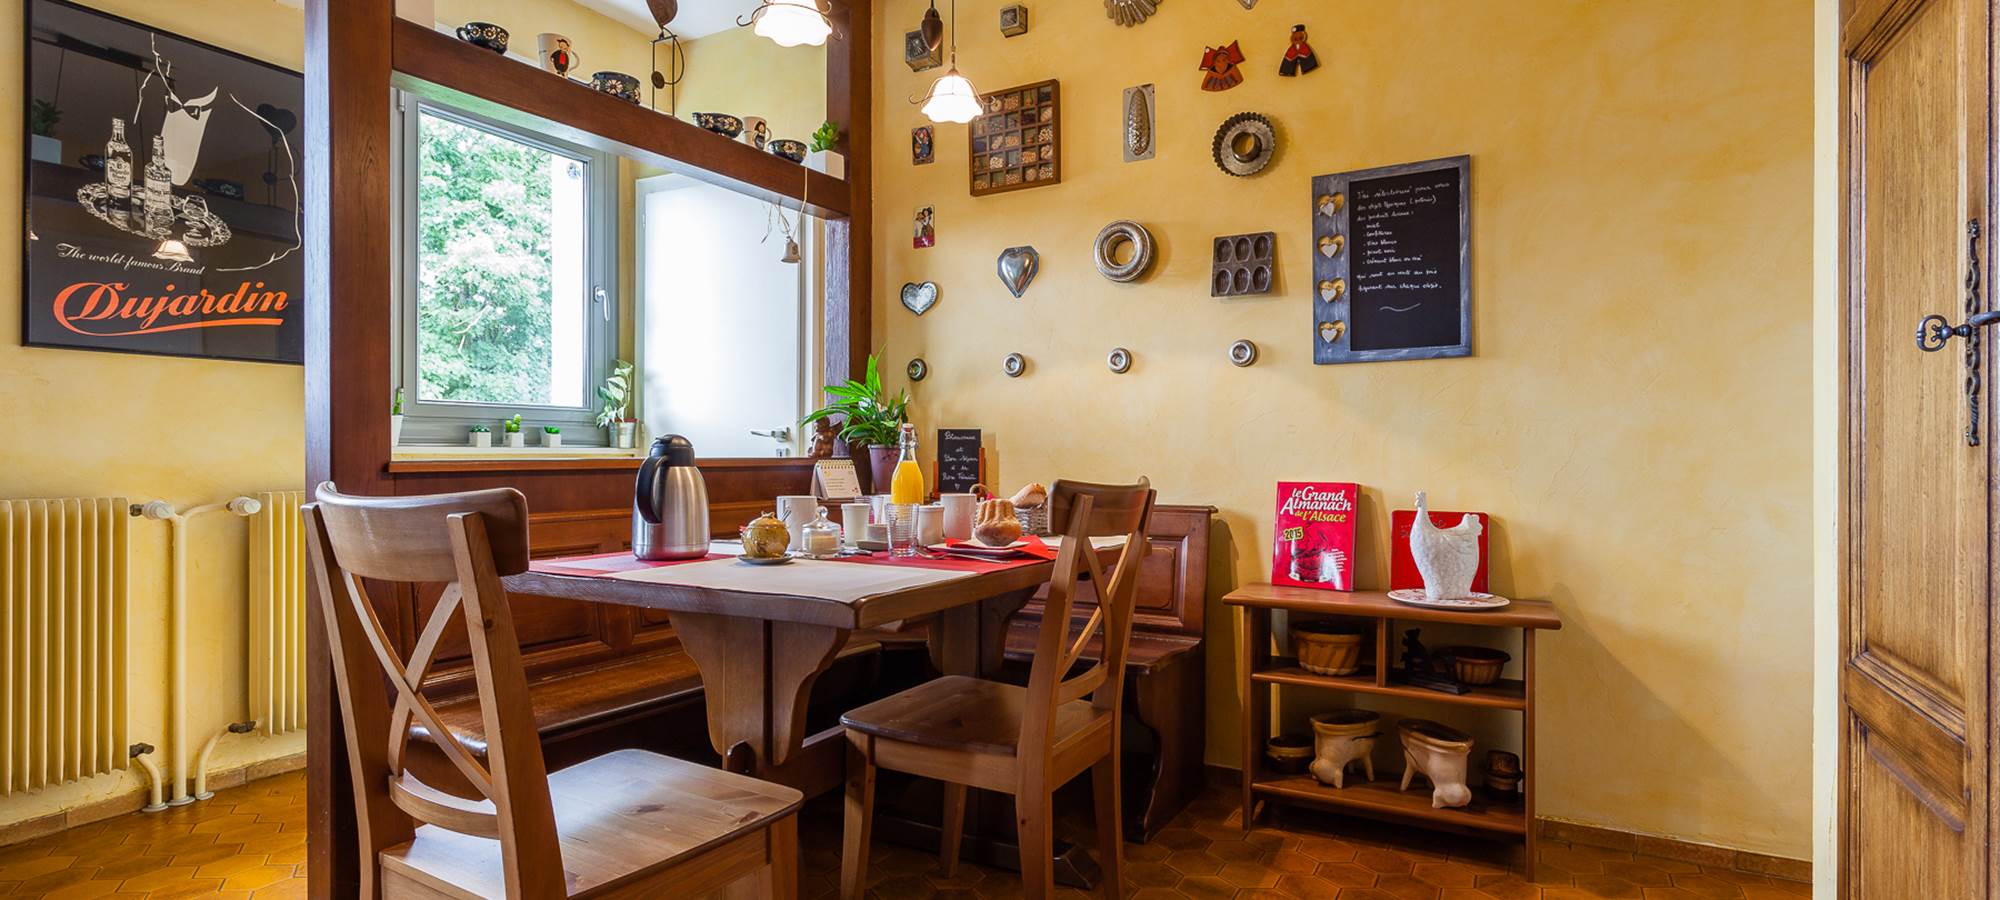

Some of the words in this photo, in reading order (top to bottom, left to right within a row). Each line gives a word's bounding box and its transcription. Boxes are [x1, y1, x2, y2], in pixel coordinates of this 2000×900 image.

[56, 242, 87, 260] The
[89, 253, 165, 271] world-famous
[165, 260, 204, 275] Brand
[53, 281, 289, 337] Dujardin
[1292, 487, 1302, 498] le
[1301, 486, 1345, 502] Grand
[1280, 497, 1352, 515] Almanach
[1302, 510, 1346, 522] l'Alsace
[1284, 527, 1303, 540] 2015
